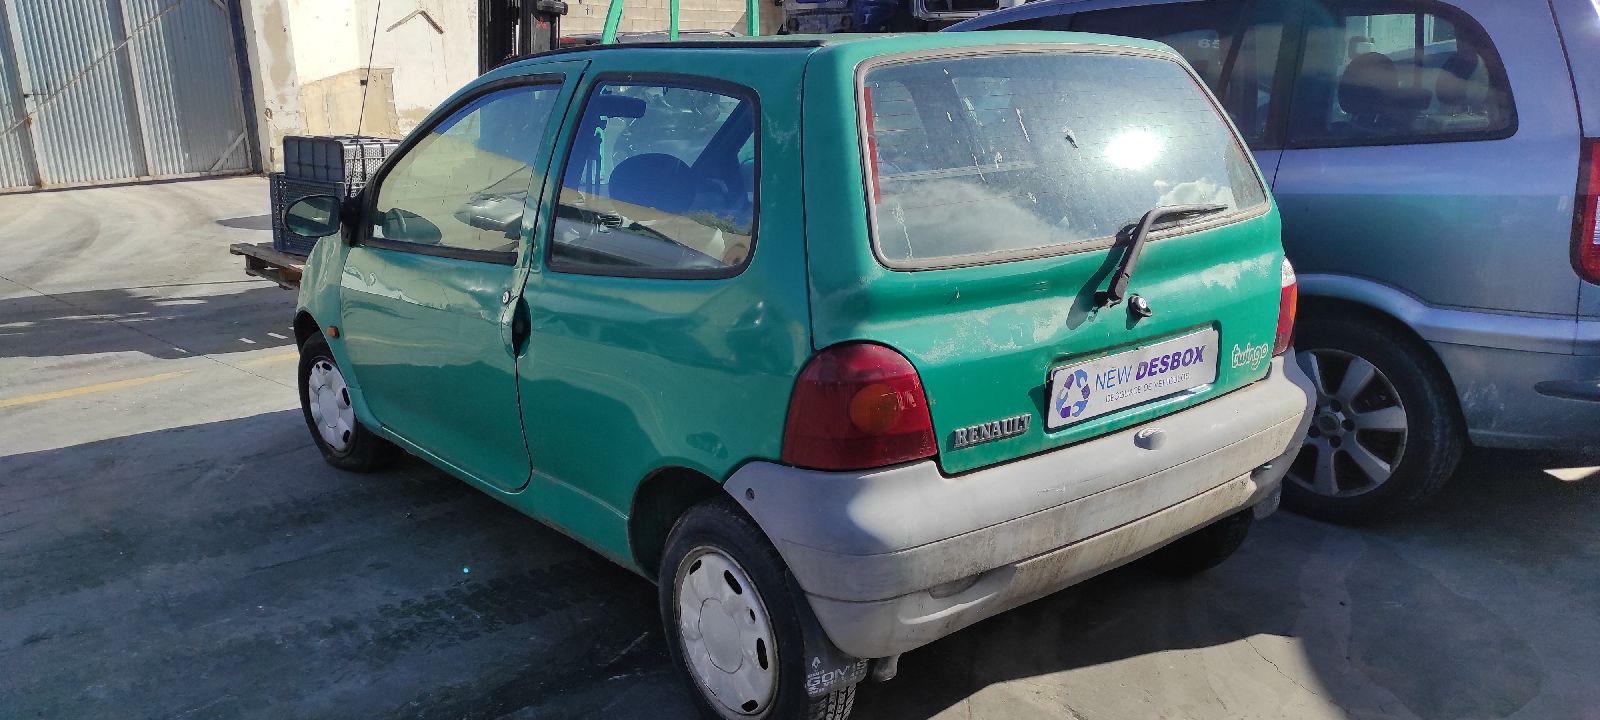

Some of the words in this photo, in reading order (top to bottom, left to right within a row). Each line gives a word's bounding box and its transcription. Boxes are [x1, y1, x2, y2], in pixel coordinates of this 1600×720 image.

[1095, 365, 1133, 392] NEW
[1135, 344, 1207, 381] DESBOX
[1231, 342, 1269, 370] twingo
[953, 413, 1032, 448] RENAULT
